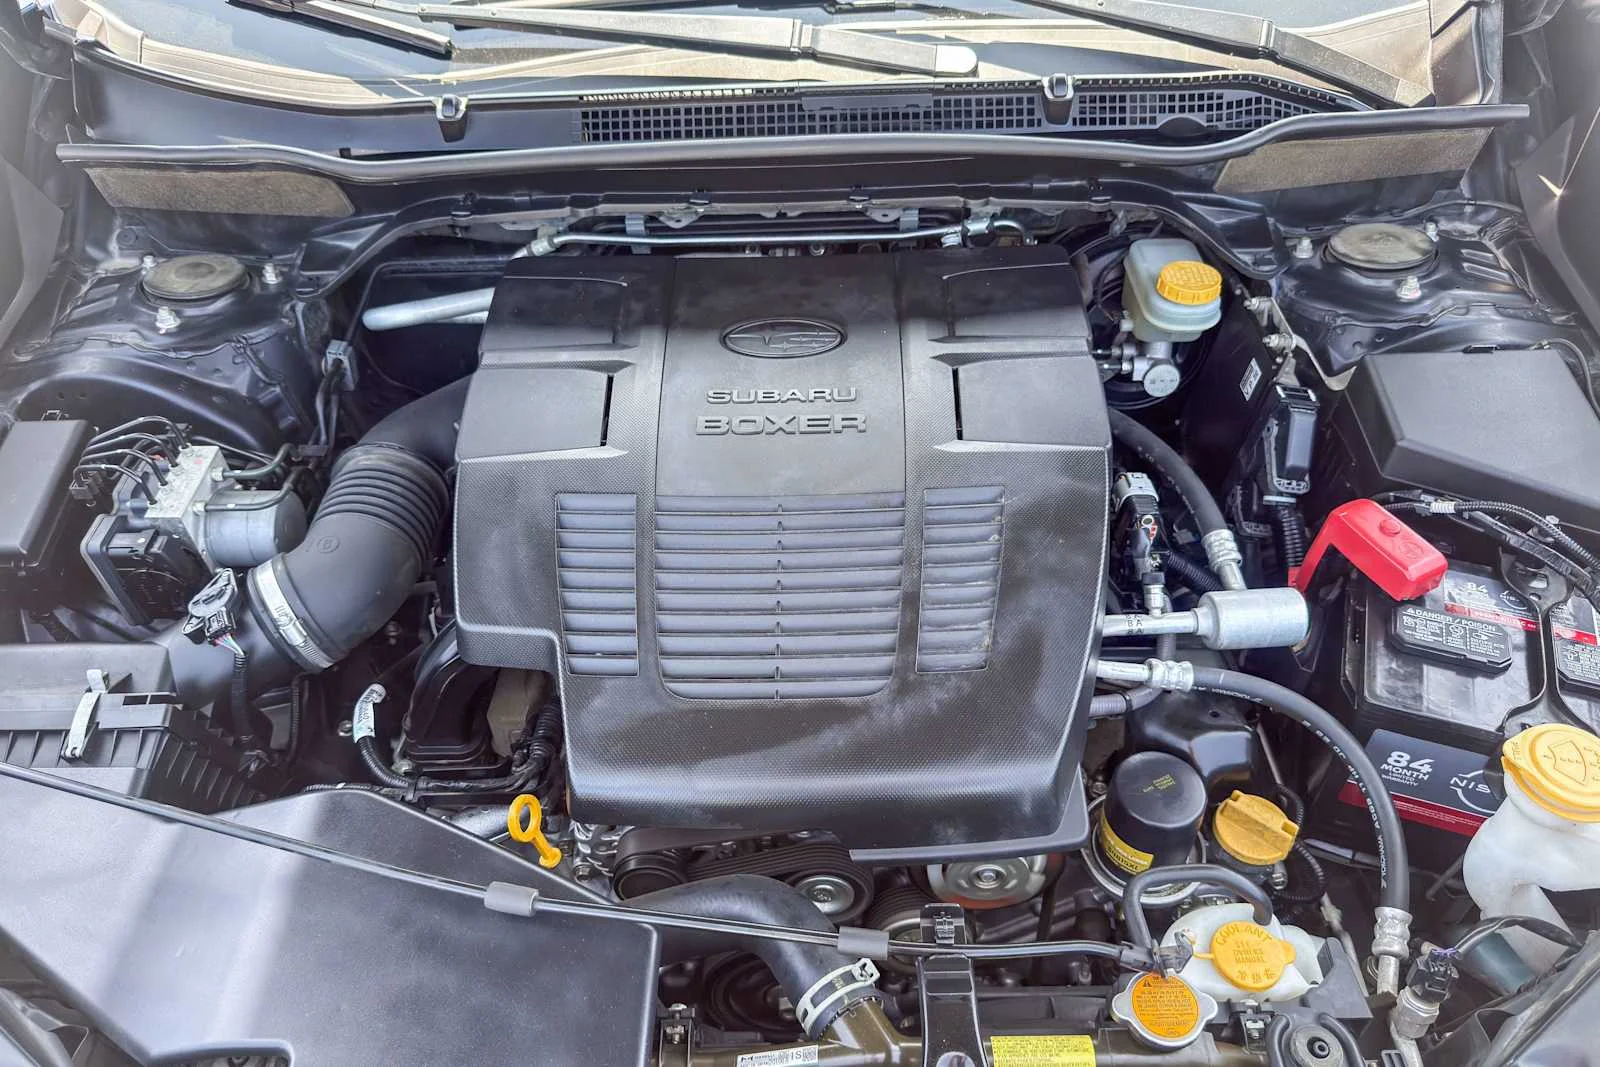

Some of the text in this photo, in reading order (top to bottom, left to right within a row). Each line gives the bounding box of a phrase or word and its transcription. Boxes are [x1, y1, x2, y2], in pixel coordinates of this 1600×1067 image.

[706, 387, 856, 404] SUBARU
[695, 413, 866, 435] BOXER
[1414, 609, 1453, 624] DANGER
[1461, 620, 1496, 632] POISON
[1387, 751, 1435, 773] 84
[1380, 763, 1429, 780] MONTH
[1381, 773, 1419, 786] WARRANTY
[1388, 772, 1415, 782] LIMITED
